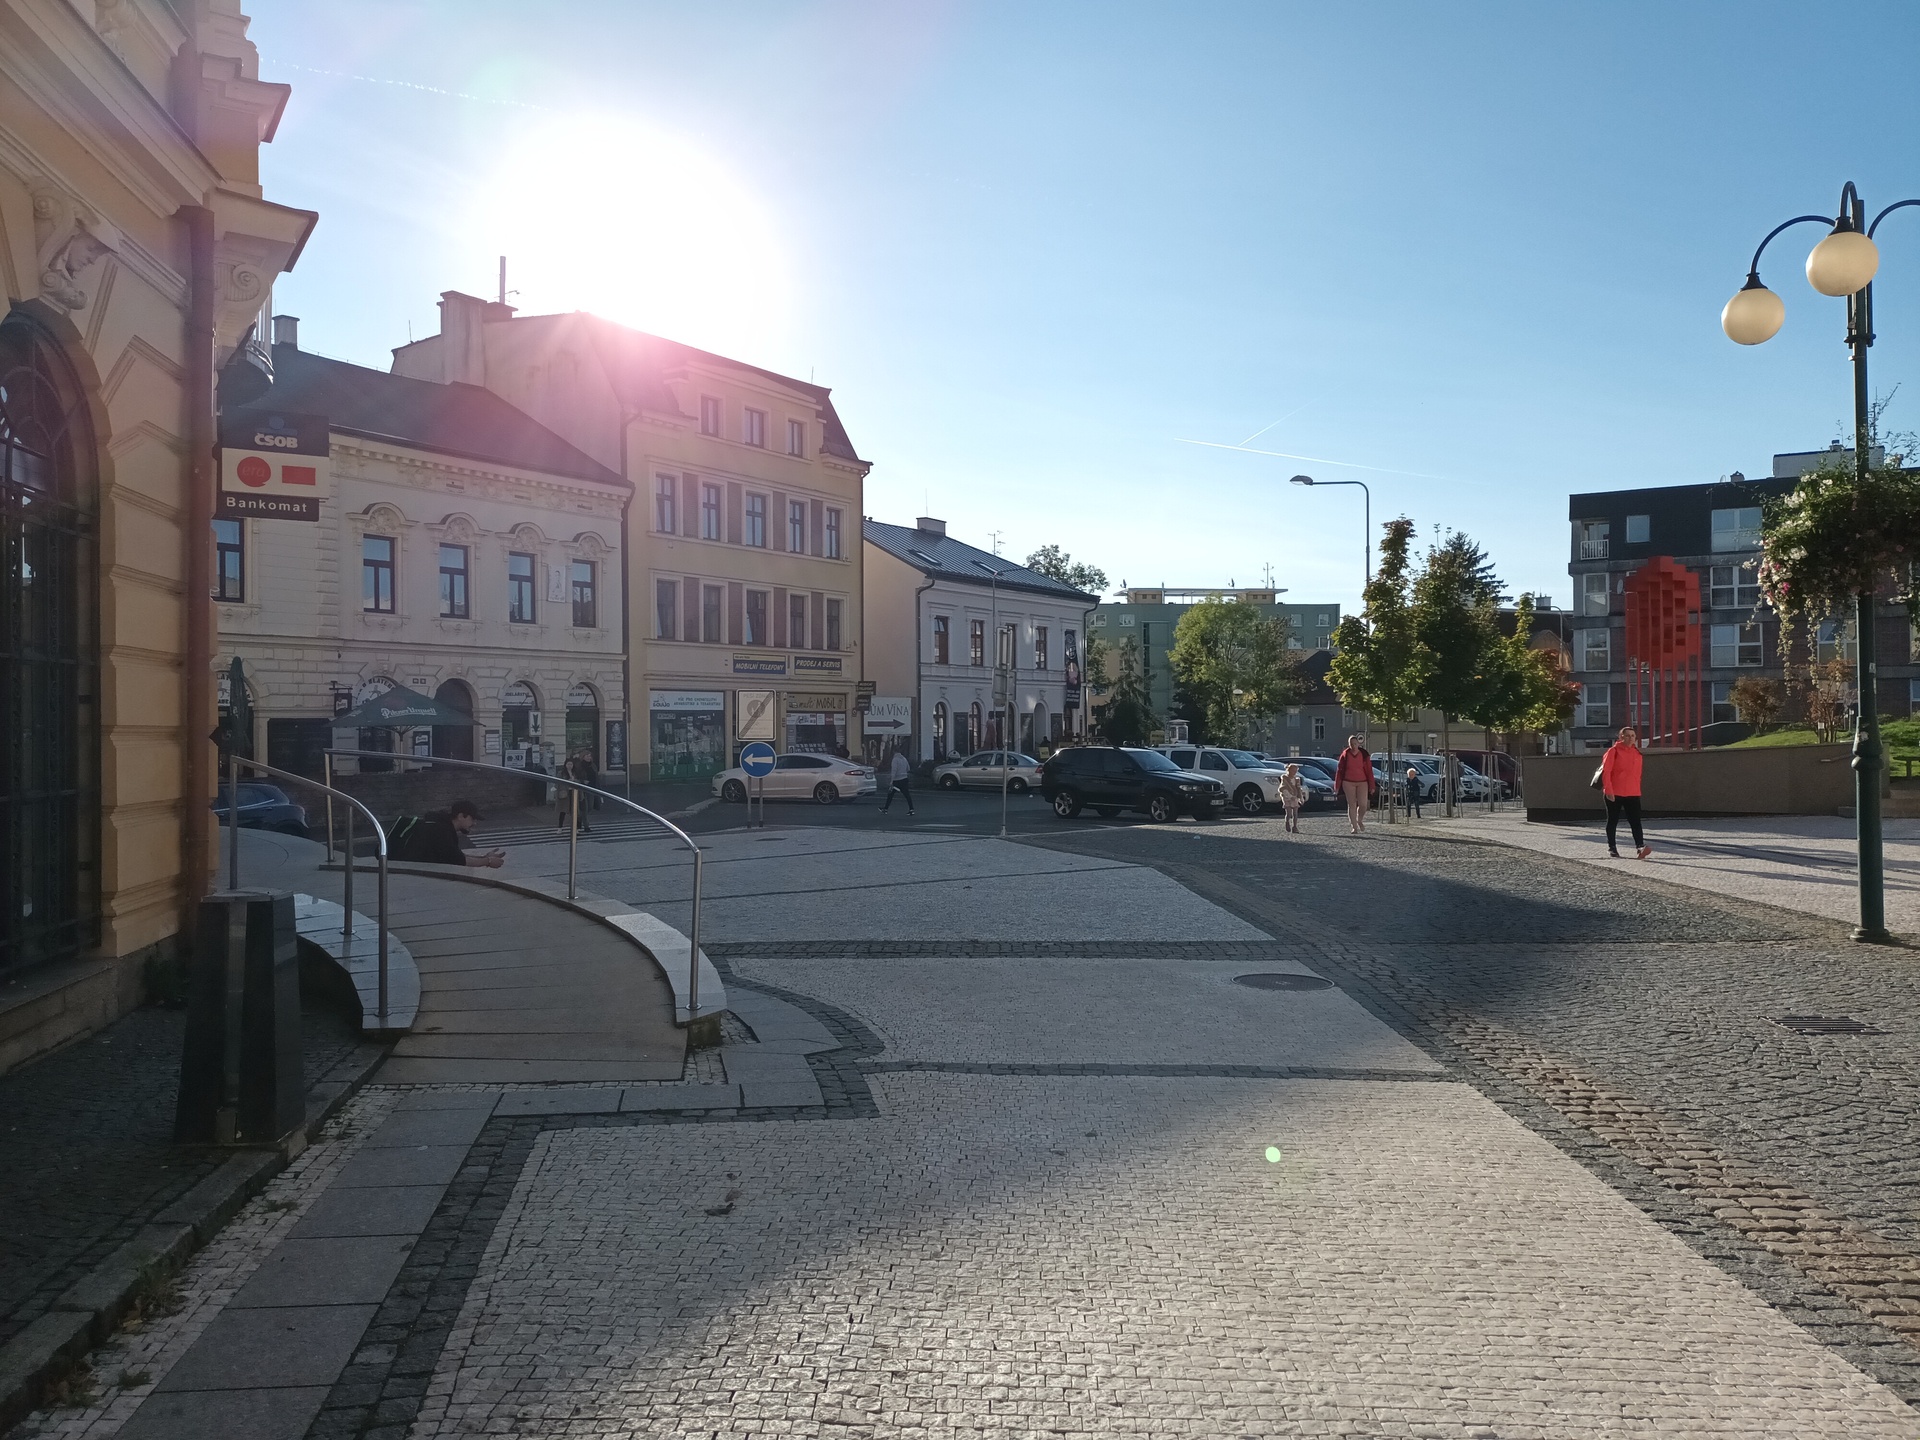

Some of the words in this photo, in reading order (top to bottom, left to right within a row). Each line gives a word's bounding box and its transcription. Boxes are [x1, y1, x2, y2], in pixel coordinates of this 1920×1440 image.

[254, 432, 298, 449] ČSOB
[226, 496, 307, 513] Bankomat
[735, 662, 759, 670] MOBILNÍ
[759, 663, 785, 671] TELEFONY
[796, 659, 816, 667] PRODEJ
